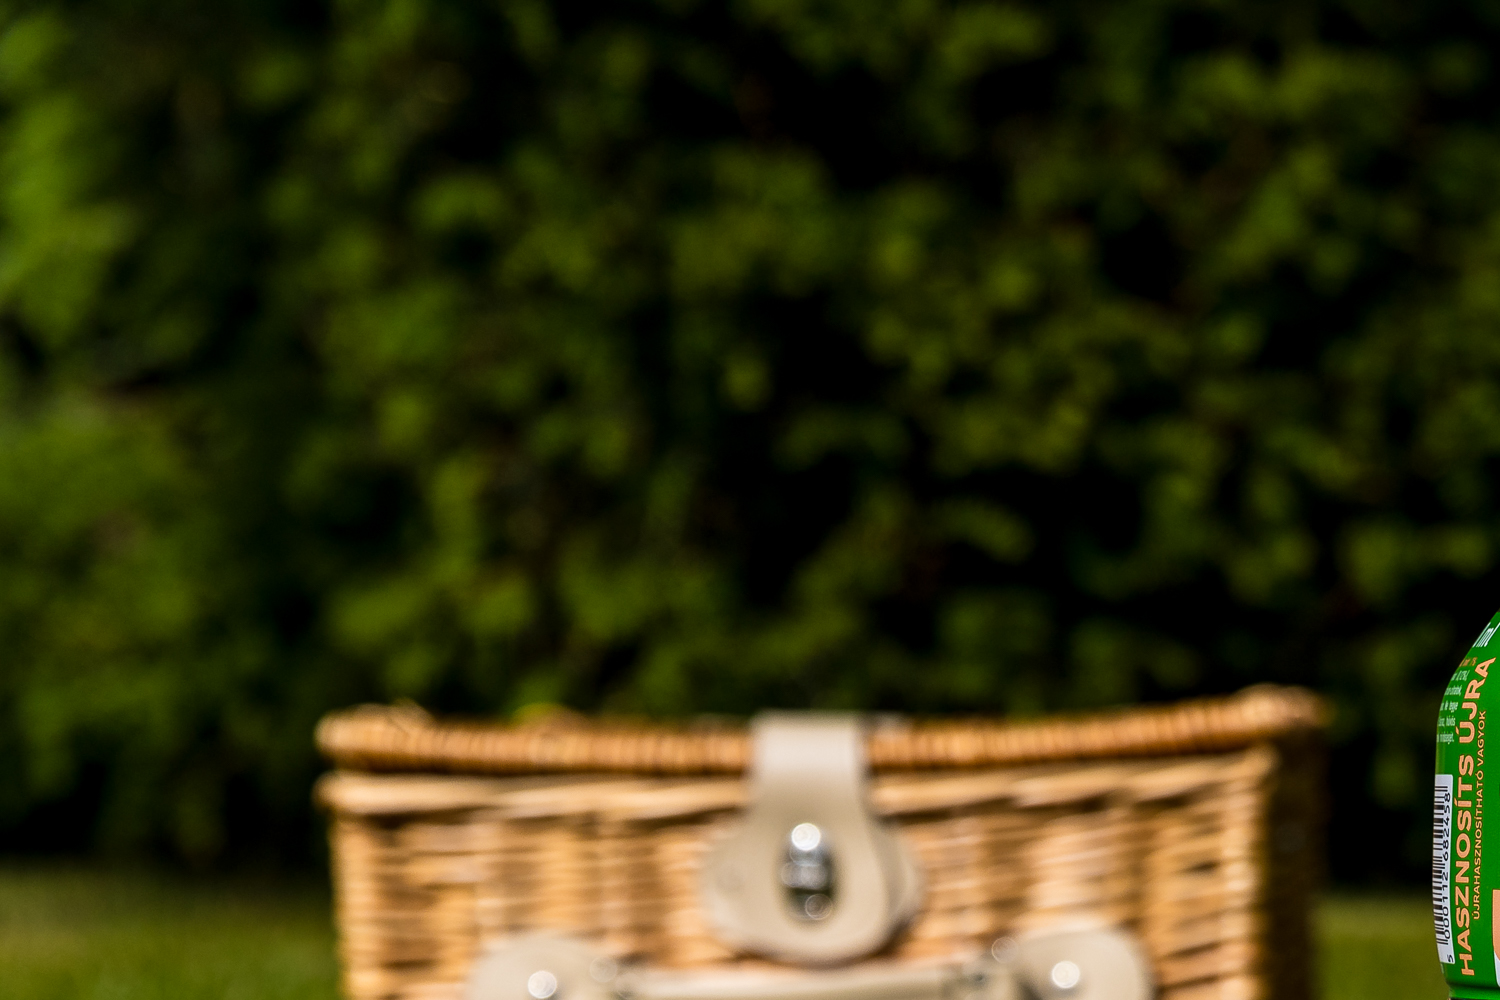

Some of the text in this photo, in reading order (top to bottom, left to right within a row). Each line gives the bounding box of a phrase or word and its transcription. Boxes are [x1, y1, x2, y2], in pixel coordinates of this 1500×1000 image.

[1455, 656, 1497, 744] ÚJRA
[1454, 754, 1475, 976] HASZNOSÍTS
[1472, 710, 1487, 920] ÚJRAHASZNOSÍTHATÓ VAGYOK
